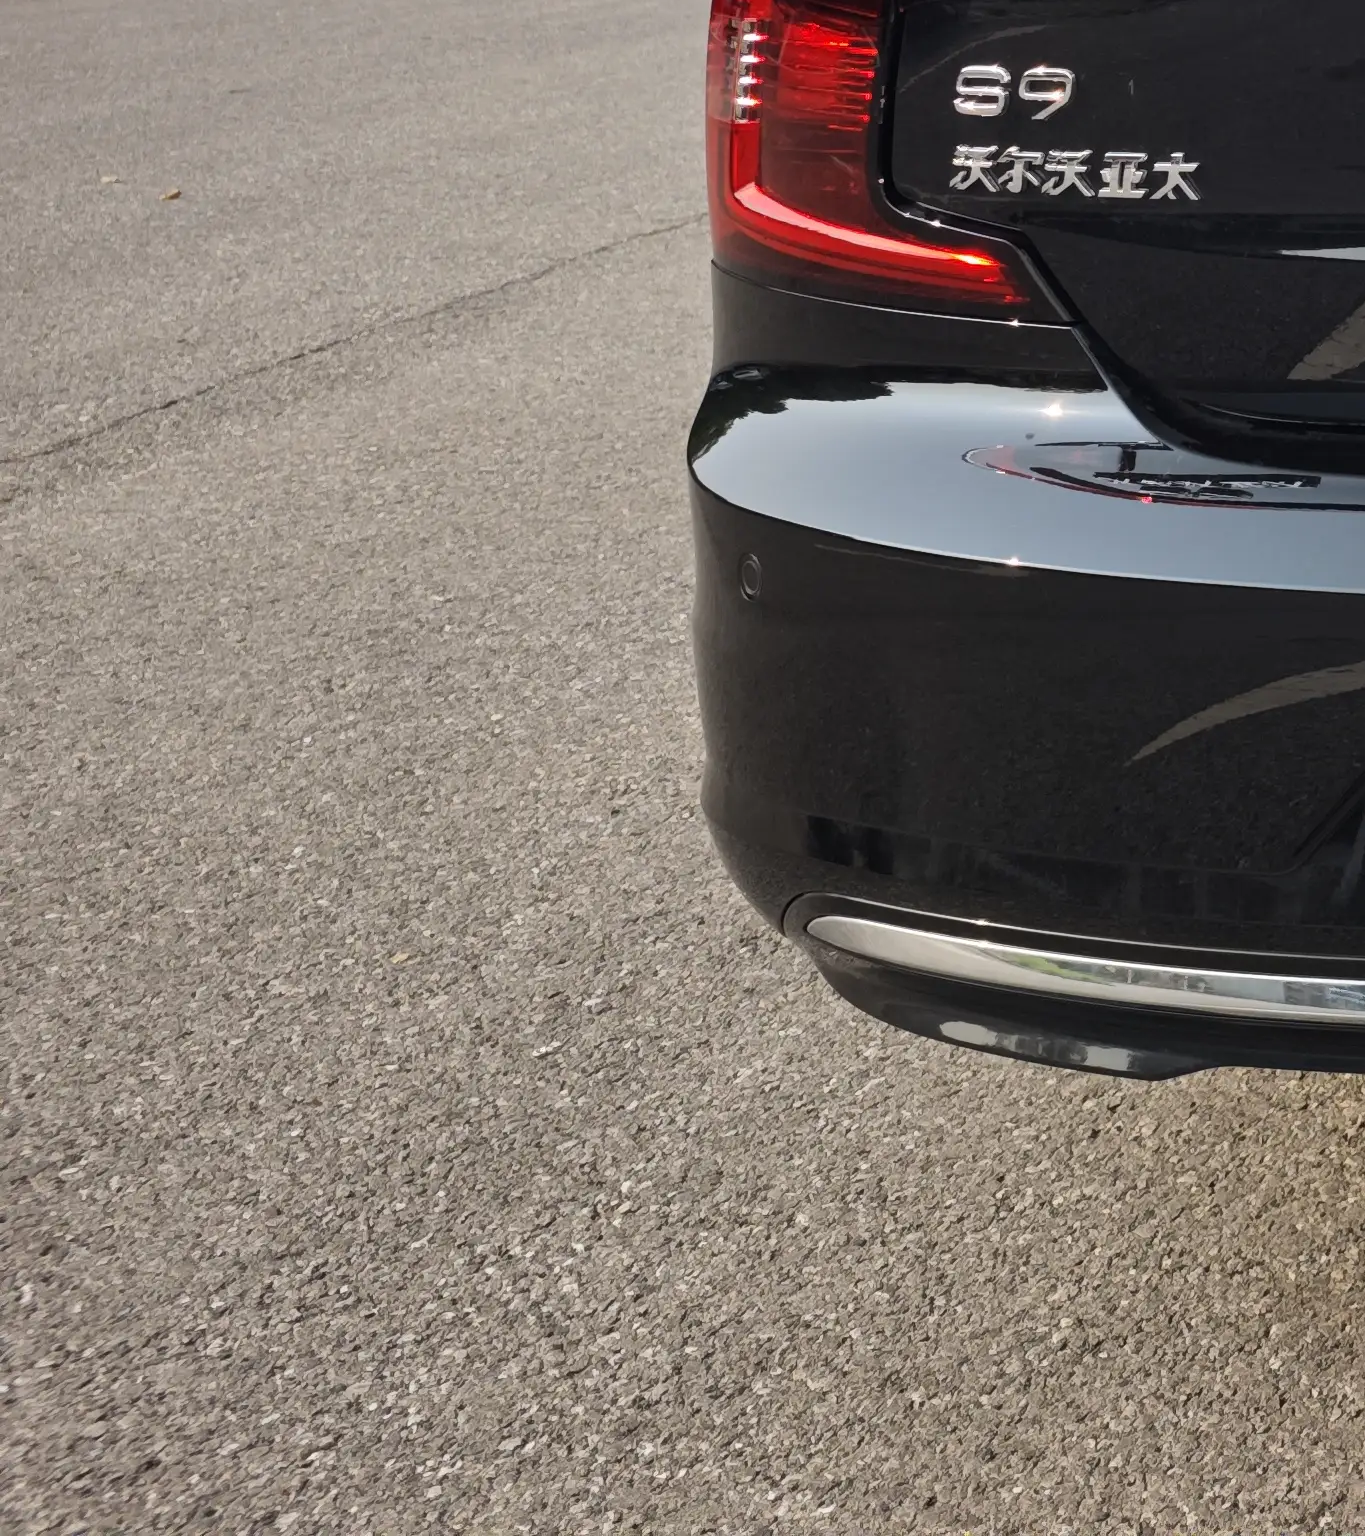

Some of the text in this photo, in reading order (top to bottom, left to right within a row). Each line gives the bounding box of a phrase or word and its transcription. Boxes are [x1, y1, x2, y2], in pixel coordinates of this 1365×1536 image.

[953, 64, 1077, 121] S9
[949, 143, 1204, 201] 沃尔沃亚太
